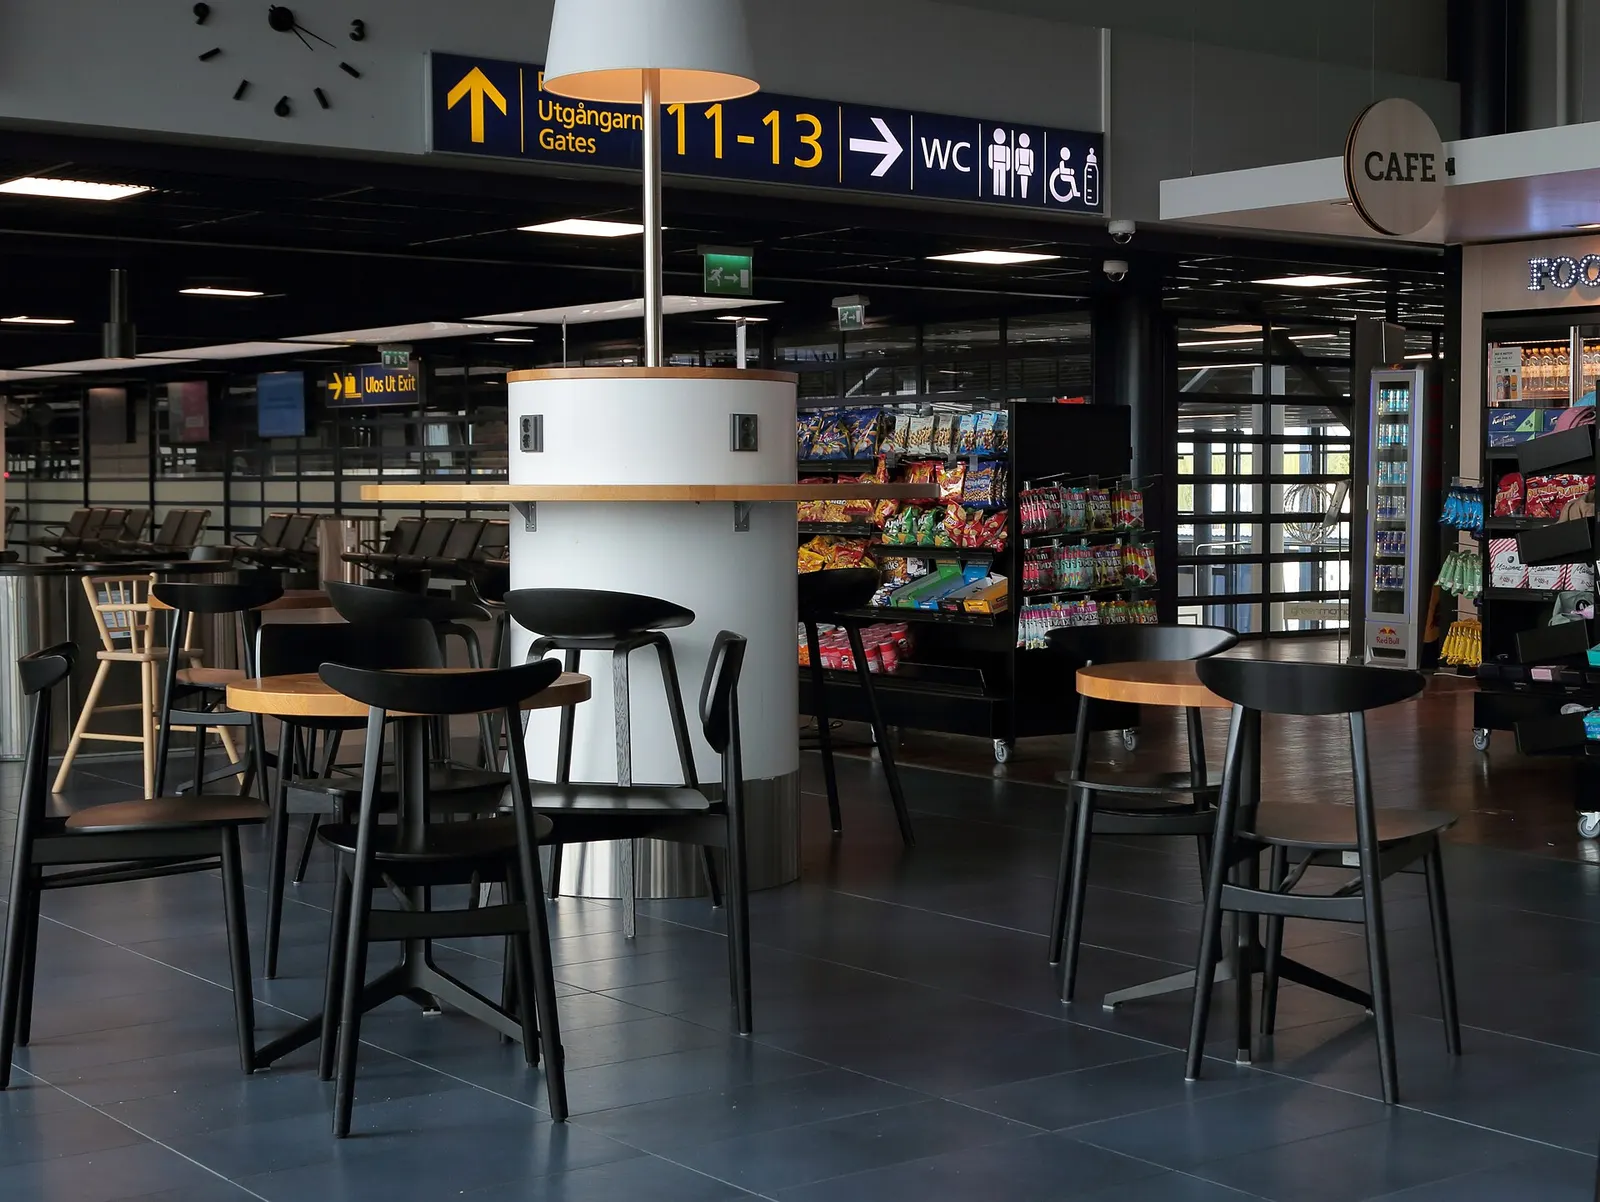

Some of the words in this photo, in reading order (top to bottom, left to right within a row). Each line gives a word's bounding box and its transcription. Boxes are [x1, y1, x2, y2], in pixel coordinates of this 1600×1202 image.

[193, 2, 210, 25] 9
[349, 19, 365, 41] 3
[274, 95, 290, 117] 6
[539, 128, 597, 154] Gates
[666, 102, 824, 169] 11-13
[920, 136, 971, 173] WC
[1364, 151, 1437, 182] CAFE
[365, 375, 384, 393] Ulos
[385, 375, 396, 392] Ut
[398, 373, 416, 392] Exit
[1376, 636, 1388, 645] Red
[1389, 637, 1400, 646] Bull
